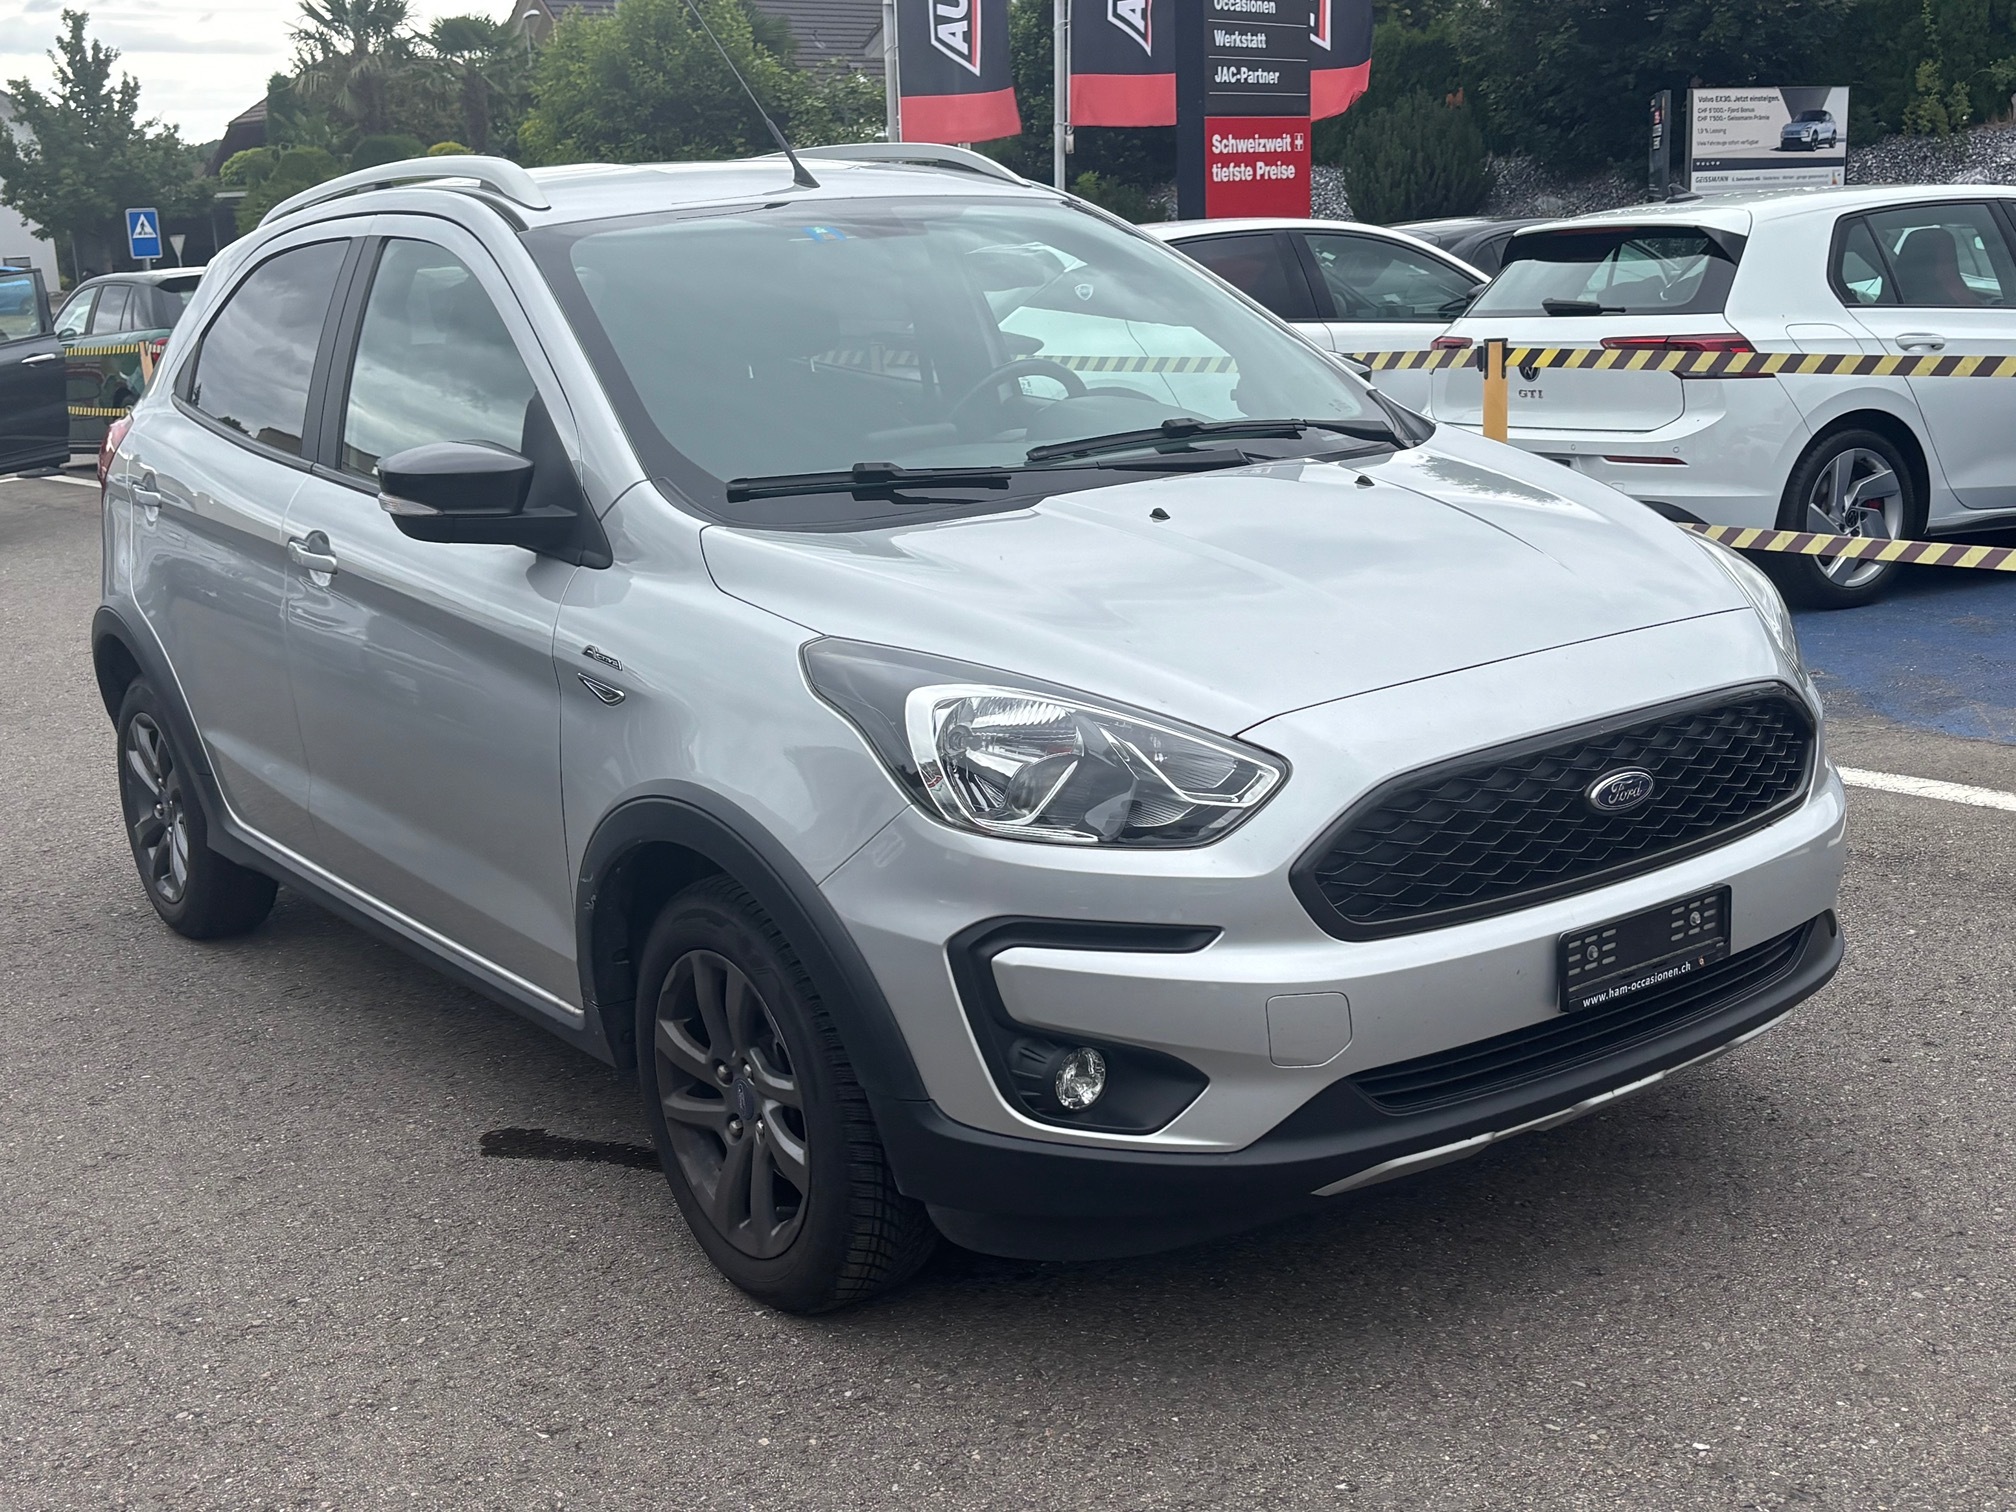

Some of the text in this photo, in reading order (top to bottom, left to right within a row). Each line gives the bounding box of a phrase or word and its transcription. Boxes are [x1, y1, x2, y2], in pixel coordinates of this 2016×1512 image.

[1213, 29, 1267, 49] Werkstatt
[1214, 66, 1280, 84] JAC-Partner
[1211, 133, 1292, 154] Schweizweit
[1211, 161, 1296, 182] tiefste Preise
[1518, 389, 1544, 399] GTI
[1608, 780, 1643, 805] Ford
[1582, 961, 1692, 1008] www.ham-occasionen.ch
